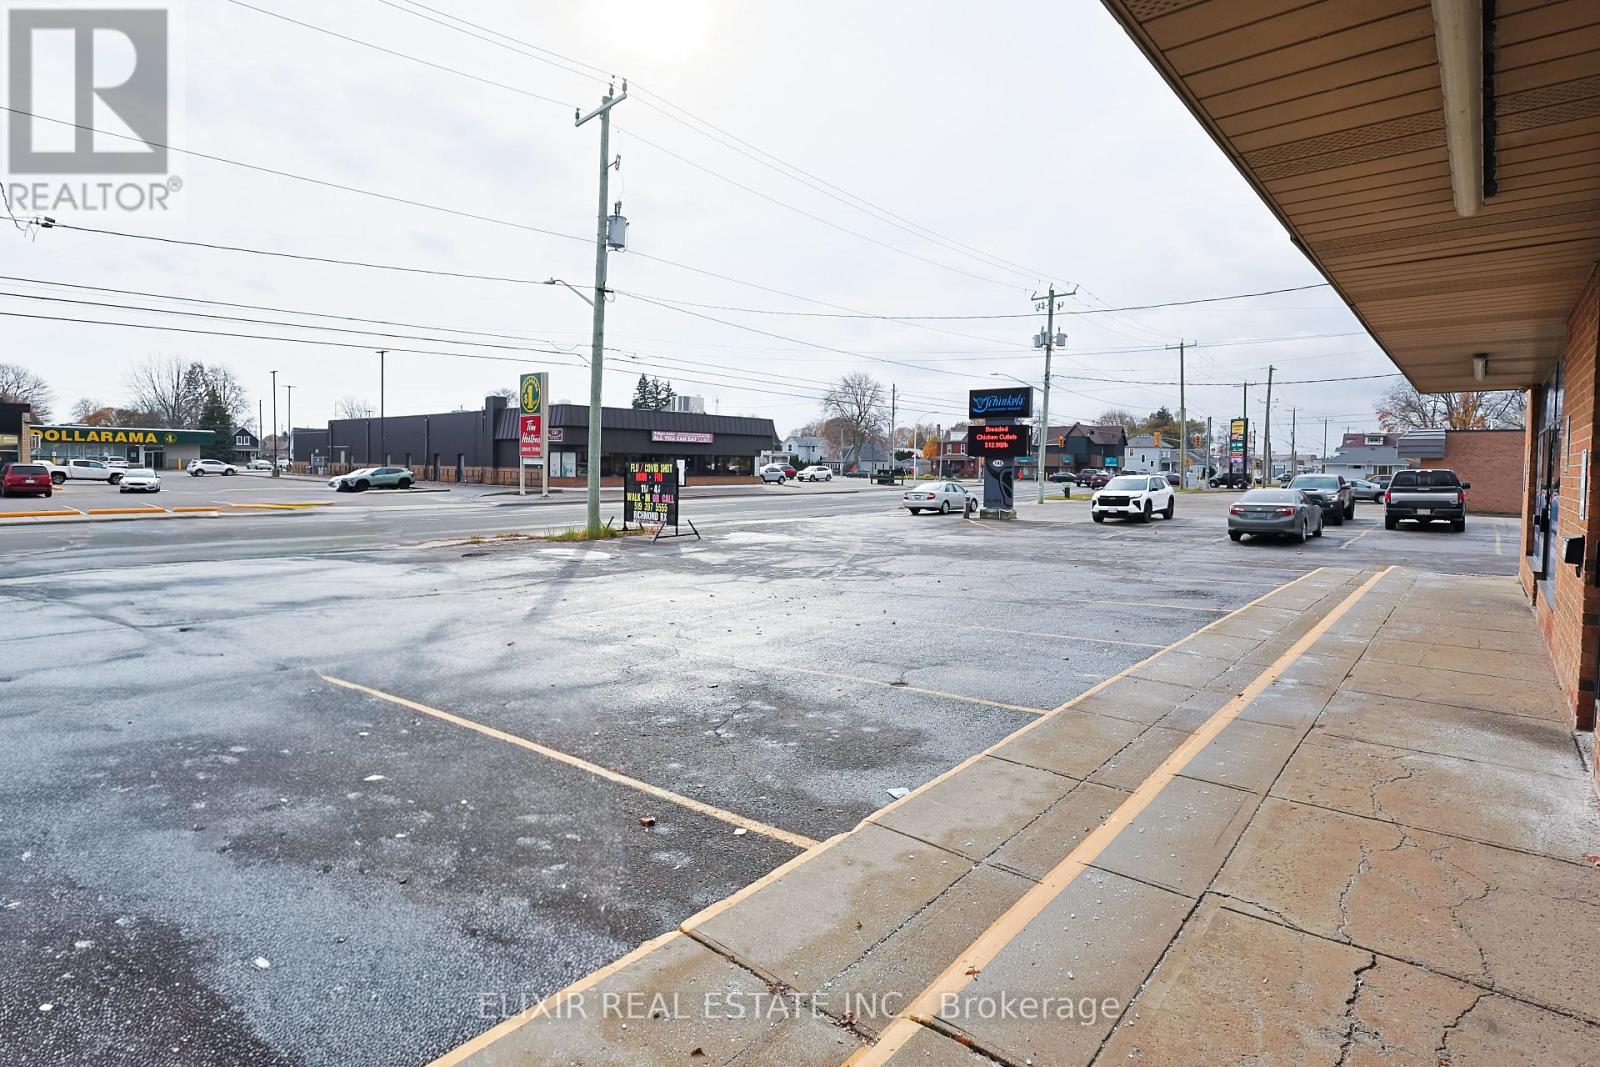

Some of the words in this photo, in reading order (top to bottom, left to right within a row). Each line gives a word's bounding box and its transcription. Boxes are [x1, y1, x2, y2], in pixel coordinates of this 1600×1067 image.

[31, 429, 157, 443] DOLLARAMA
[630, 463, 640, 472] FLU
[644, 463, 659, 473] COVID
[660, 464, 673, 473] SHOT
[661, 494, 675, 503] CALL
